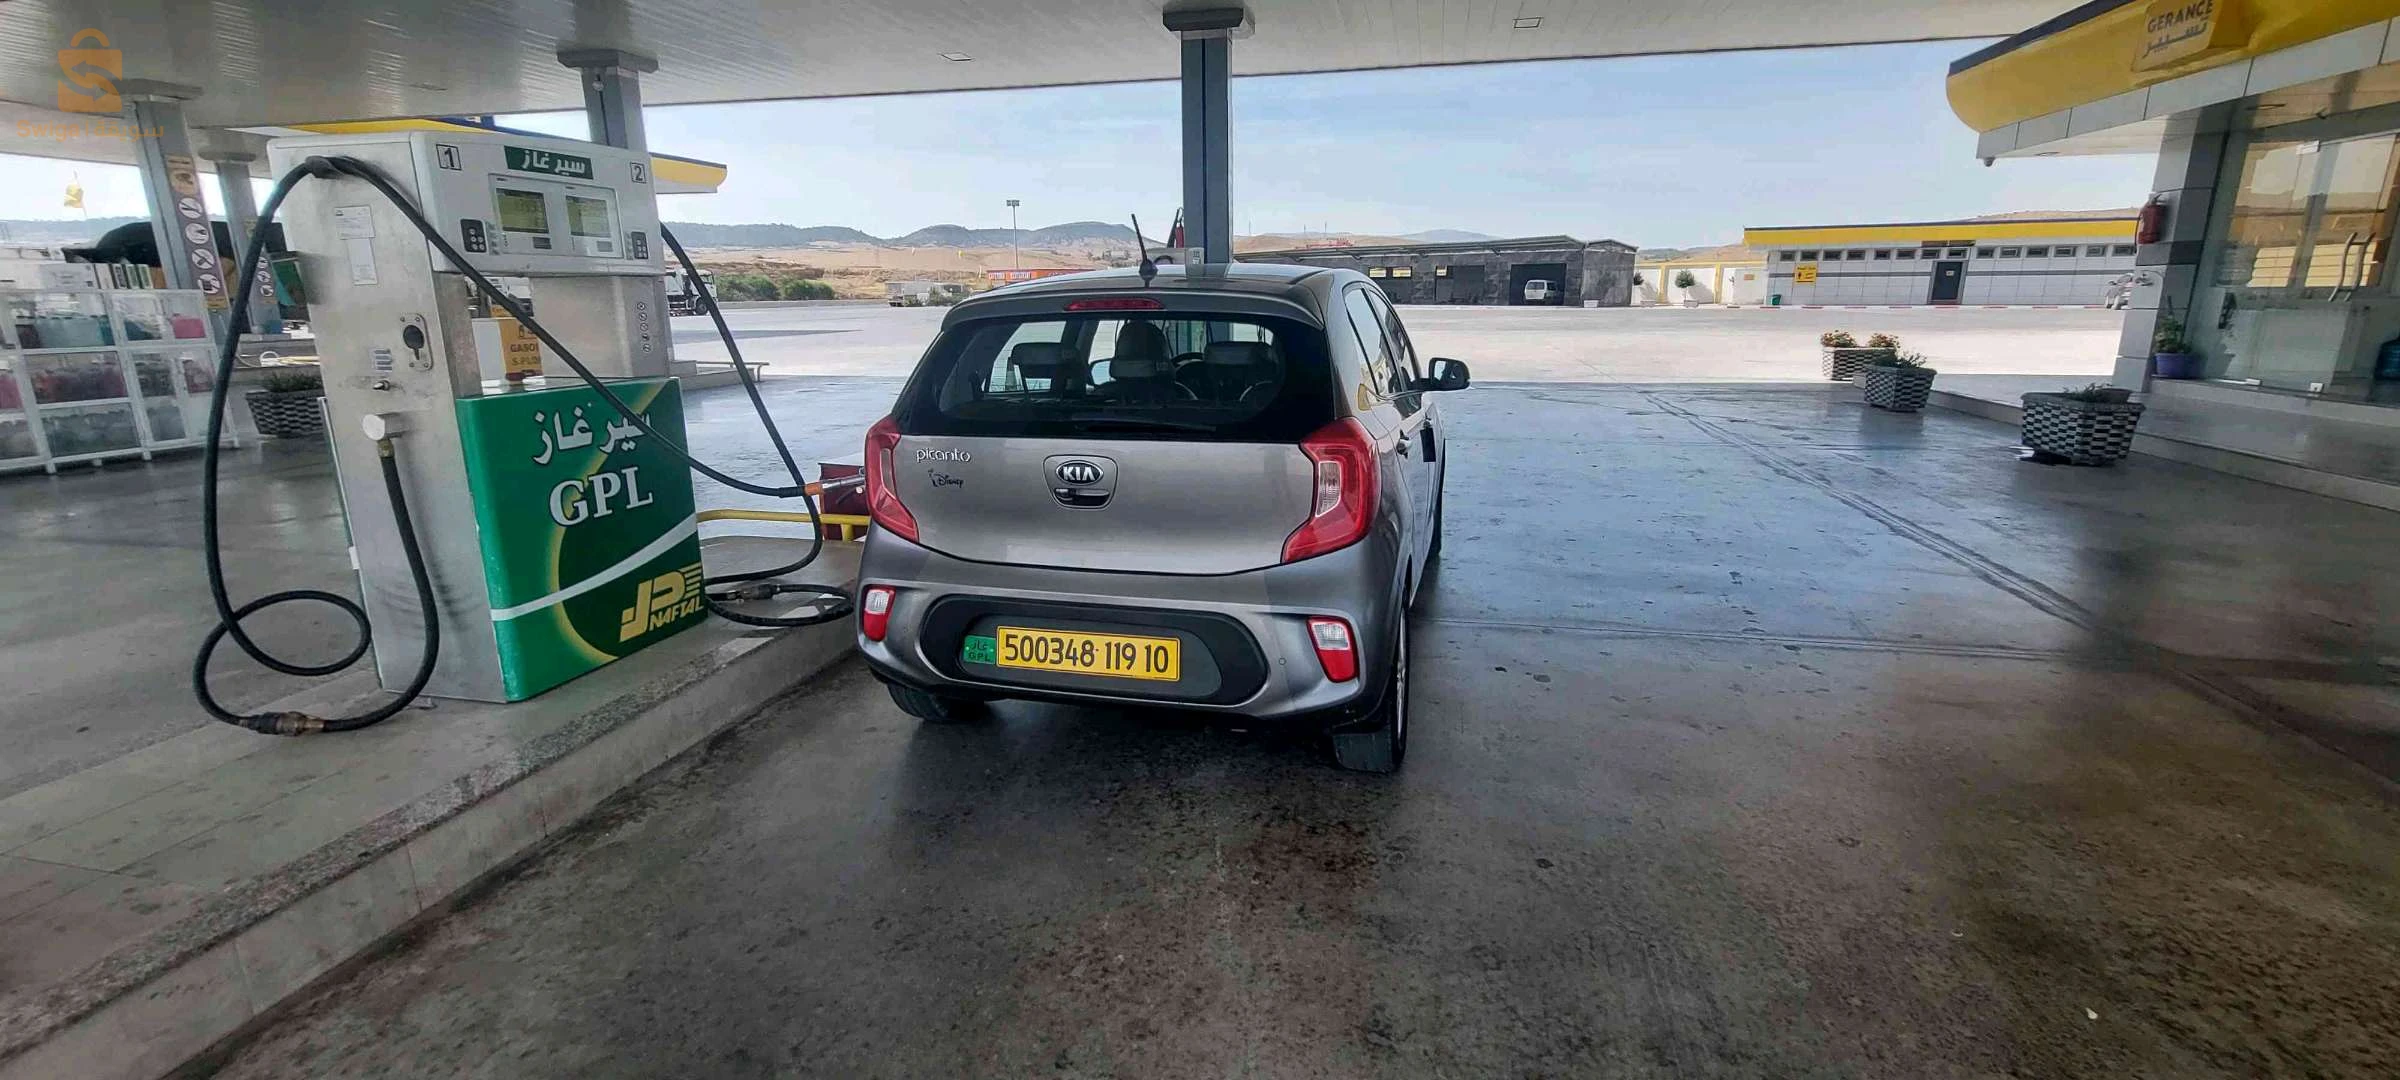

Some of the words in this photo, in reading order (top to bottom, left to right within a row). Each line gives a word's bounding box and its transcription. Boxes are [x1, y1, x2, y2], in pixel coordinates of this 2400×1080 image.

[2147, 0, 2213, 33] GERANCE
[444, 147, 455, 168] 1
[521, 149, 550, 169] غاز
[554, 158, 586, 176] سير
[634, 165, 643, 181] 2
[532, 406, 593, 465] غاز
[916, 447, 971, 463] picanto
[1062, 466, 1096, 481] KIA
[549, 466, 653, 526] GPL
[649, 595, 704, 632] NAFTAL
[968, 651, 991, 662] GPL
[1005, 633, 1095, 667] 500348
[1104, 641, 1137, 671] 119
[1144, 643, 1169, 673] 10
